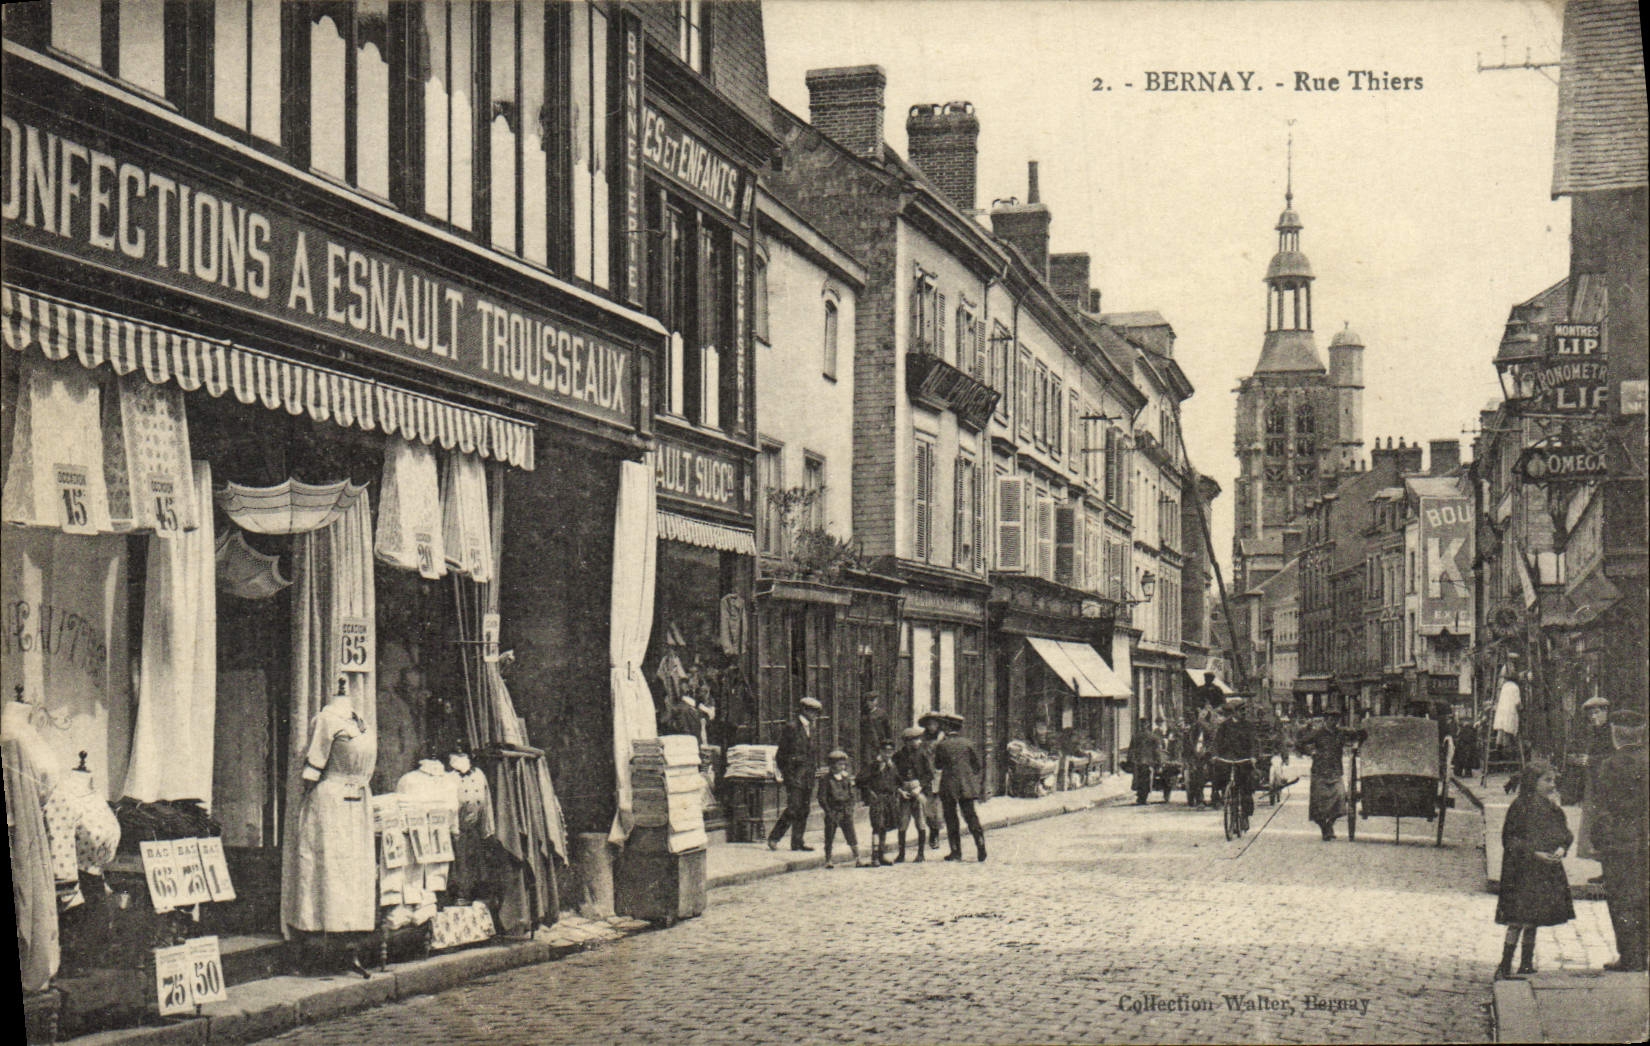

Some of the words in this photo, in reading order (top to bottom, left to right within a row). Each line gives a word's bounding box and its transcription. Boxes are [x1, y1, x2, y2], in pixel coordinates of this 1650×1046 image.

[626, 30, 638, 288] BONNETERIE
[642, 106, 665, 163] ES
[677, 132, 737, 209] ENFANTS
[2, 115, 270, 299] ONFECTIONS
[326, 240, 465, 361] ESNAULT
[477, 301, 627, 415] TROUSSEAUX
[1555, 324, 1600, 337] MONTRES
[1558, 337, 1599, 355] LIP
[1549, 453, 1608, 474] OMEGA
[62, 488, 88, 527] 15
[1426, 504, 1472, 528] BOU
[1427, 537, 1470, 598] K
[341, 634, 367, 666] 65
[152, 866, 178, 898] 65
[163, 973, 186, 1008] 75
[194, 960, 220, 996] 50
